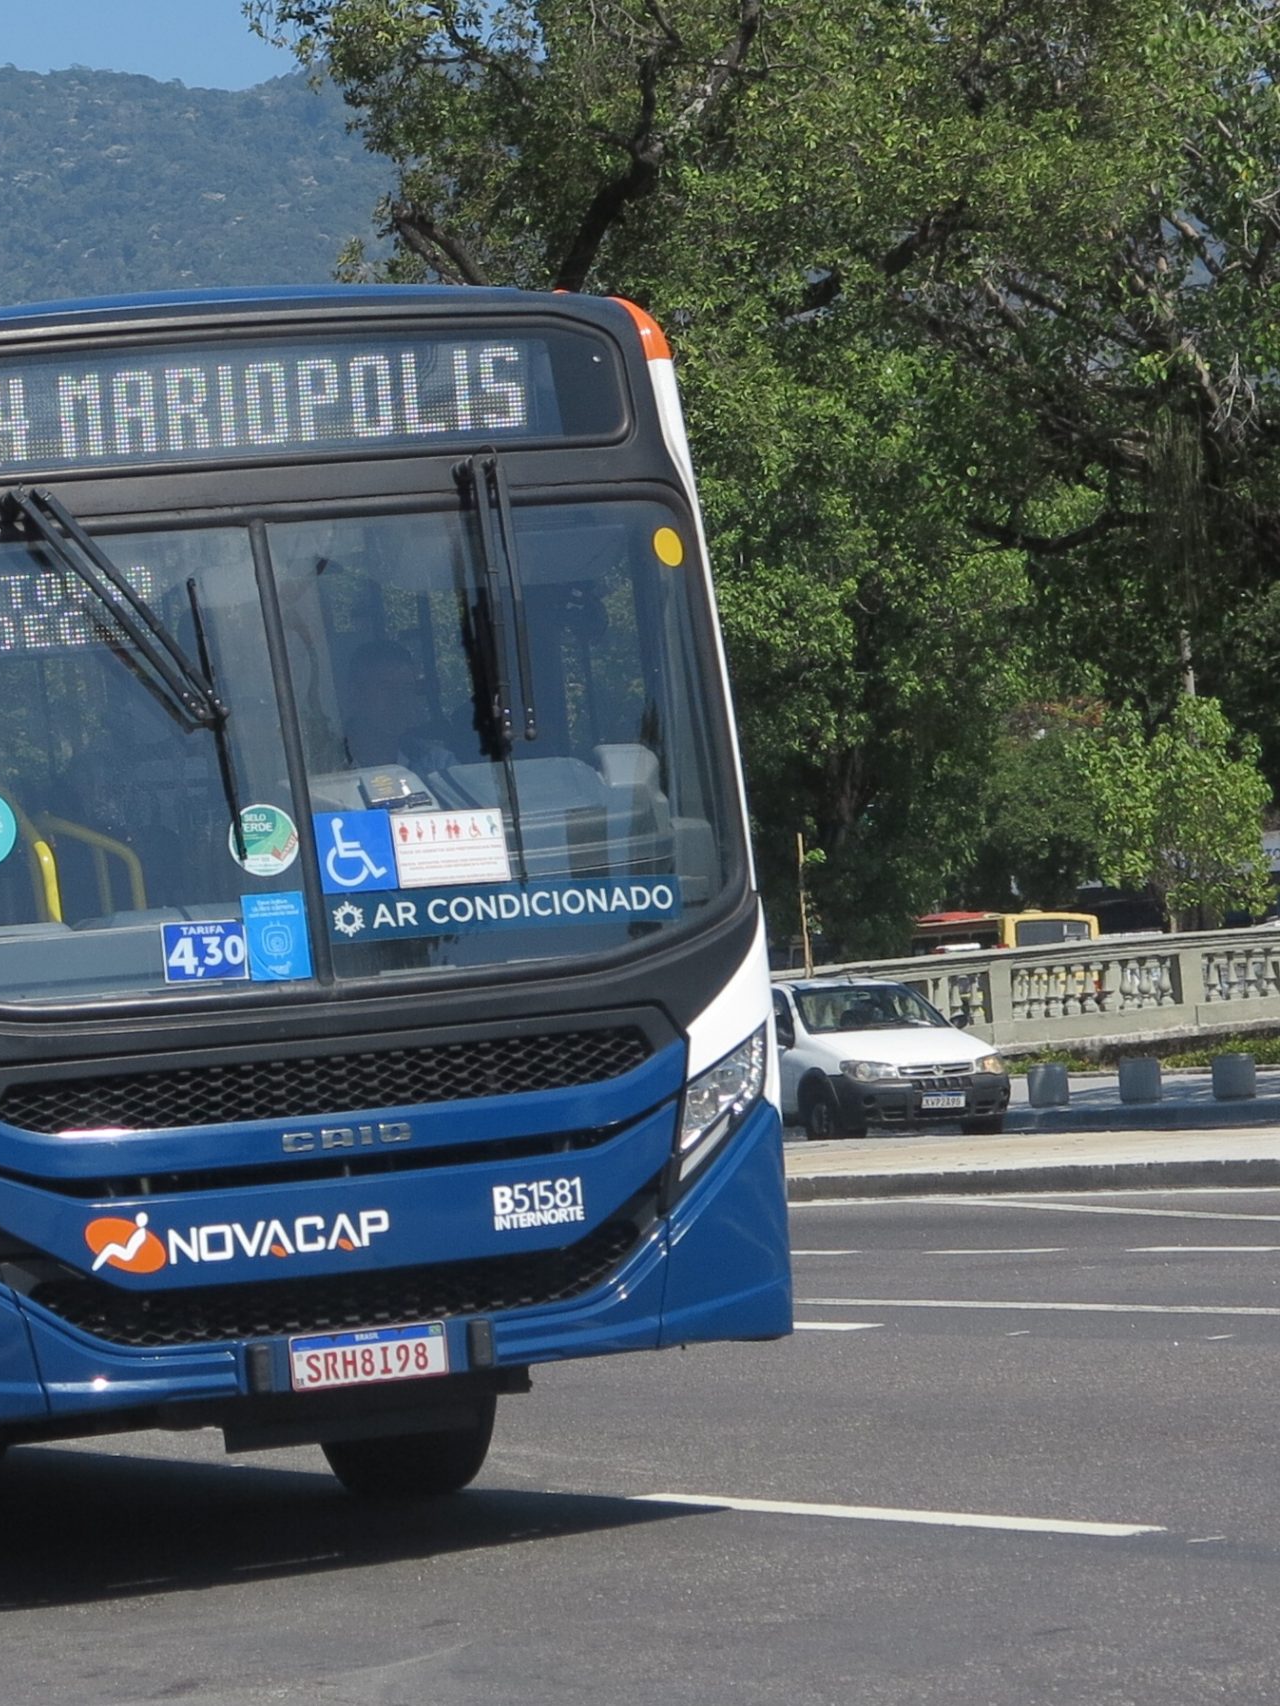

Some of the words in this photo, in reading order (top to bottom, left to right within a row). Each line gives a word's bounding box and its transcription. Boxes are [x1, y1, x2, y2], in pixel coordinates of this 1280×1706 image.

[58, 346, 526, 458] MARIOPOLIS
[241, 822, 274, 833] ERDE
[244, 813, 267, 822] SELO
[372, 900, 418, 929] AR
[427, 884, 673, 925] CONDICIONADO
[180, 925, 225, 936] TARIFA
[168, 935, 245, 977] 4,30
[282, 1122, 412, 1153] CAIO
[492, 1176, 583, 1215] B51581
[167, 1209, 390, 1265] NOVACAP
[493, 1206, 586, 1231] INTERNORTE
[305, 1342, 429, 1384] SRH8I98
